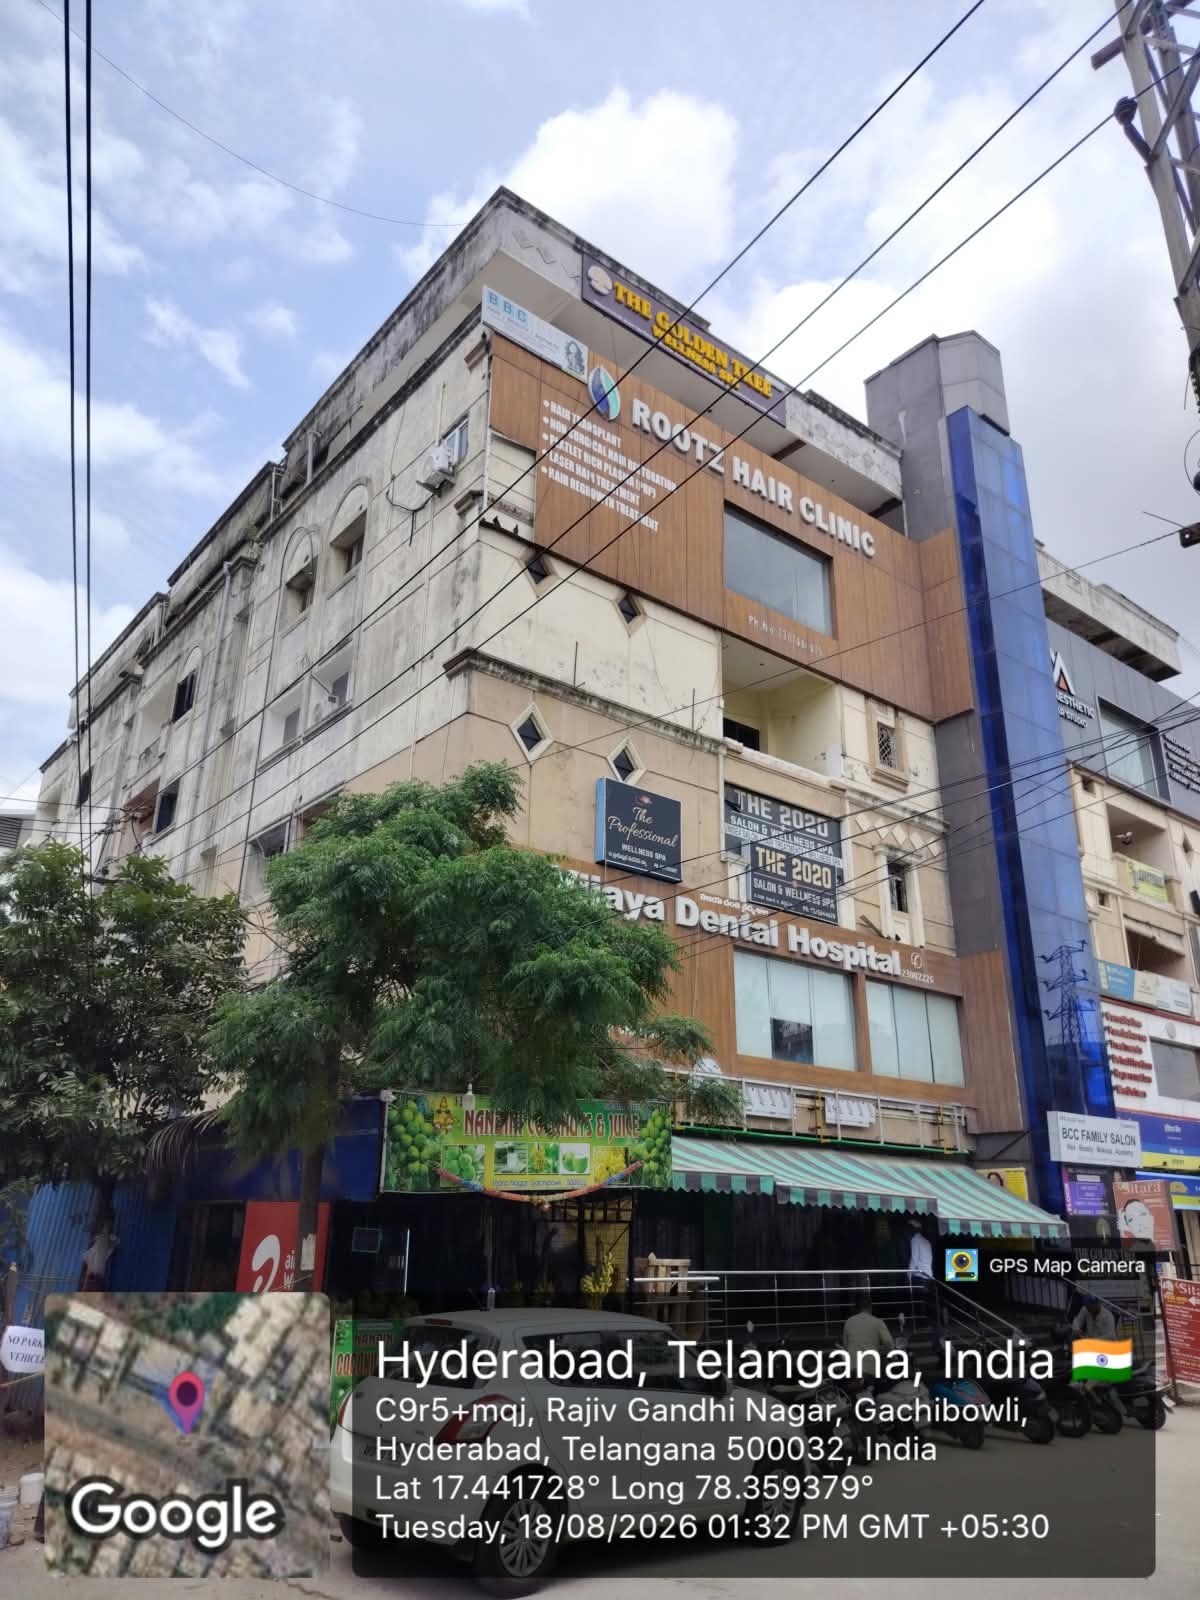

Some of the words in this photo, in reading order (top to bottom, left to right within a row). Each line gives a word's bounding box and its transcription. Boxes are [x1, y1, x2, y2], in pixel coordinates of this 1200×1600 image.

[614, 281, 652, 320] THE
[655, 311, 728, 369] GOLDEN
[731, 357, 773, 398] TREE
[550, 400, 571, 421] HAIR
[549, 450, 575, 473] LASER
[583, 450, 602, 469] RICH
[607, 448, 627, 467] HAIR
[548, 466, 569, 488] HAIR
[632, 398, 725, 475] ROOTZ
[732, 456, 794, 514] HAIR
[799, 496, 876, 558] CLINIC
[632, 806, 653, 825] The
[735, 789, 773, 820] THE
[780, 805, 829, 838] 2020
[607, 815, 679, 848] Professional
[730, 815, 760, 833] SALON
[770, 827, 815, 851] WELLNESS
[621, 843, 654, 859] WELLNESS
[654, 852, 667, 863] SPA
[755, 846, 787, 877] THE
[792, 858, 832, 889] 2020
[753, 878, 777, 894] SALON
[675, 895, 779, 948] Dental
[787, 923, 902, 976] Hospital
[595, 1112, 606, 1138] &
[608, 1113, 640, 1144] JUICE
[1062, 1128, 1080, 1141] BCC
[1081, 1130, 1108, 1144] FAMILY
[1110, 1133, 1136, 1147] SALON
[8, 1335, 20, 1345] NO
